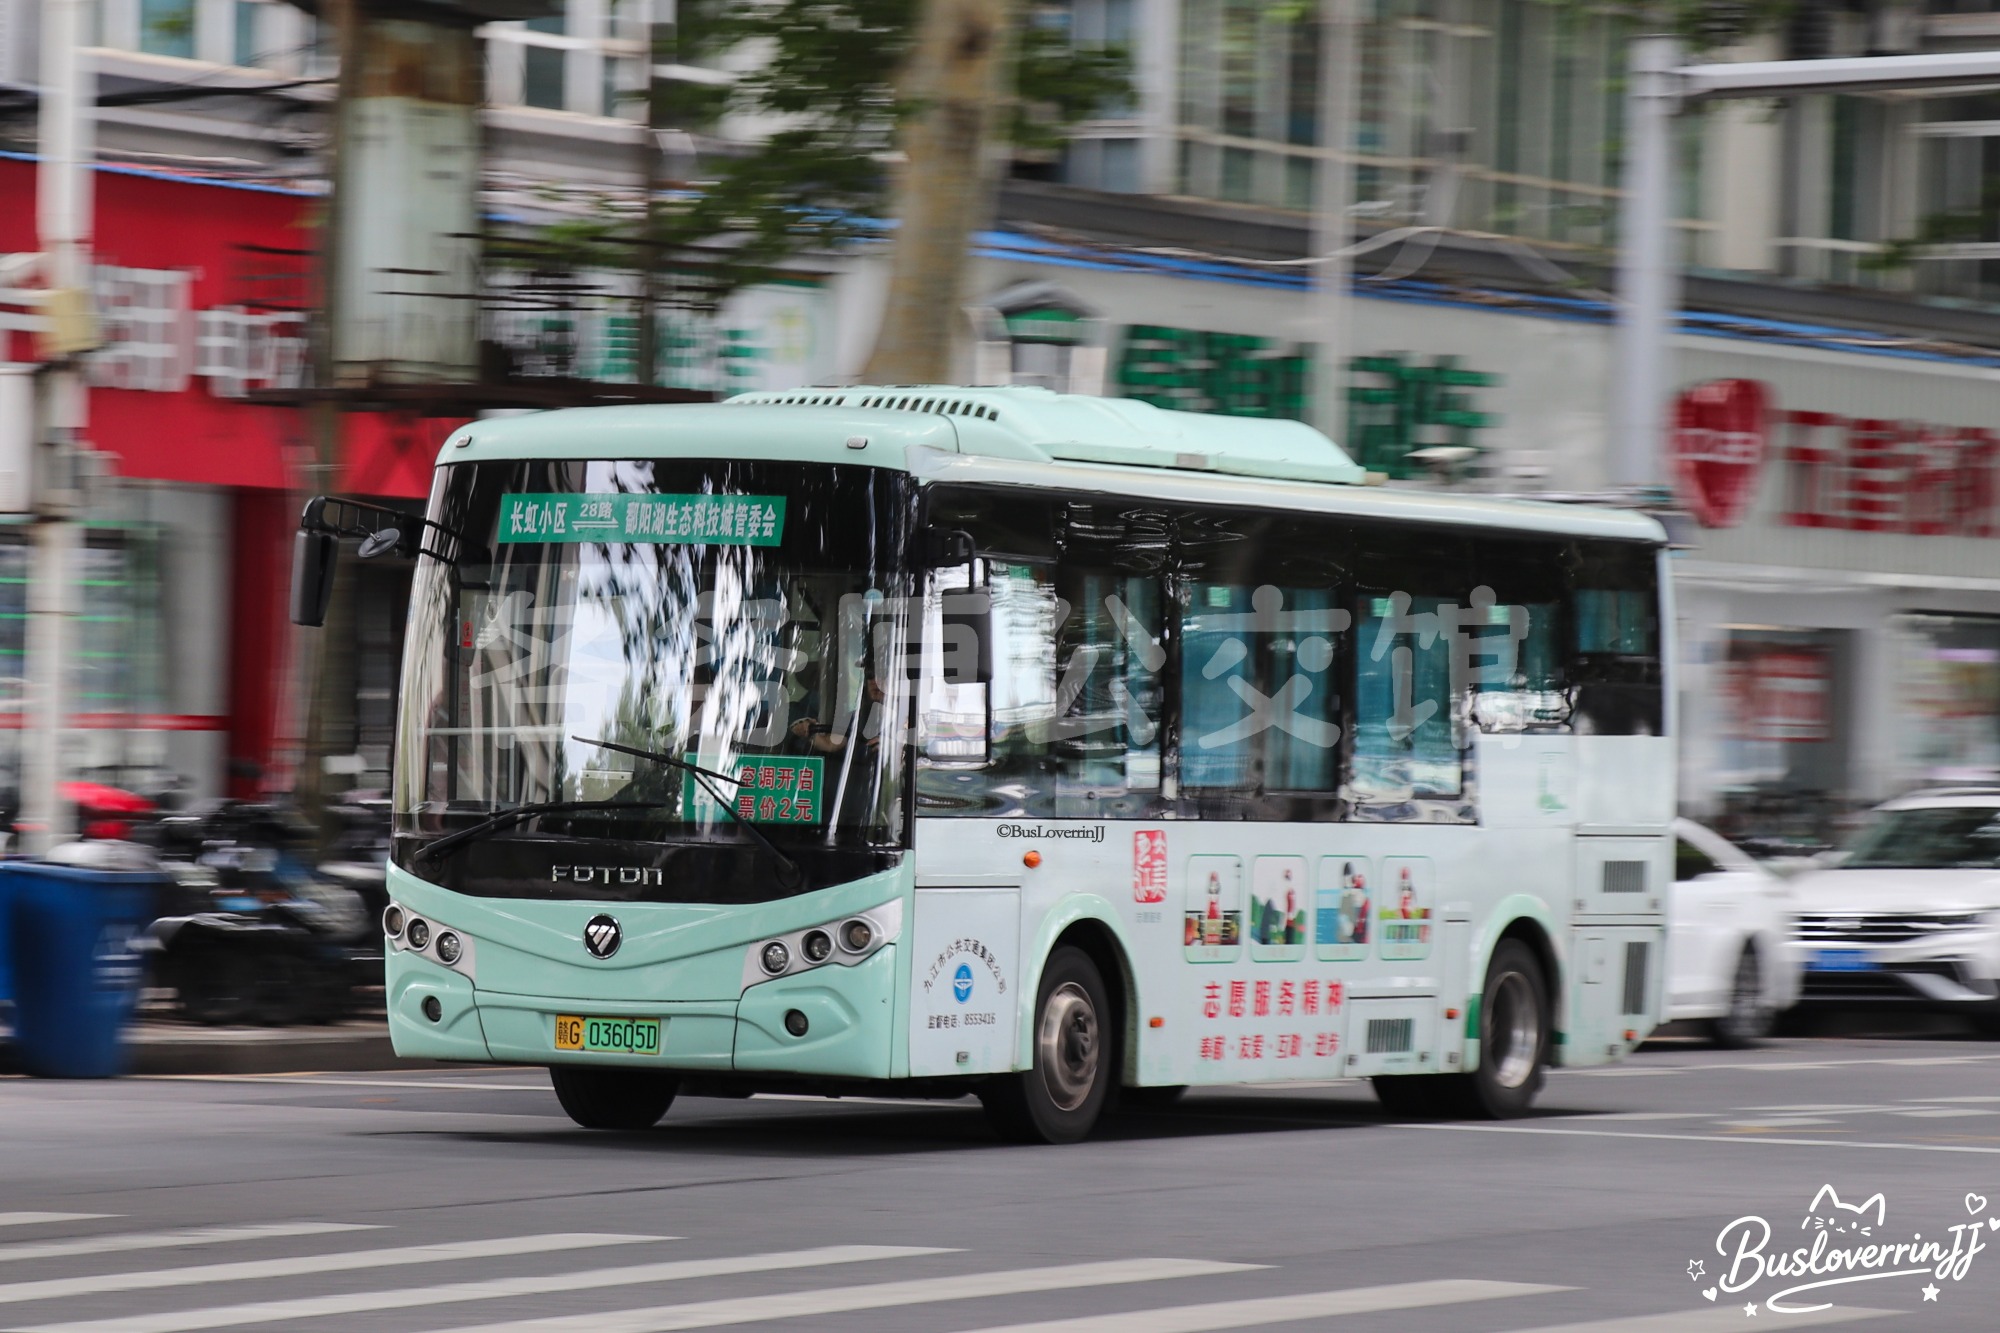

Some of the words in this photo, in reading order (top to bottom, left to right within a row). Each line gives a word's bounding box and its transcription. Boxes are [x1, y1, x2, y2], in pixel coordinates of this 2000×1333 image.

[510, 501, 567, 535] 长虹小区
[580, 503, 613, 519] 28路
[625, 503, 777, 538] 鄱阳湖生态科技城管委会
[740, 766, 814, 791] 空调开启
[738, 795, 812, 821] 票价2元
[552, 864, 663, 885] FOTON
[1203, 979, 1344, 1019] 志愿服务精神
